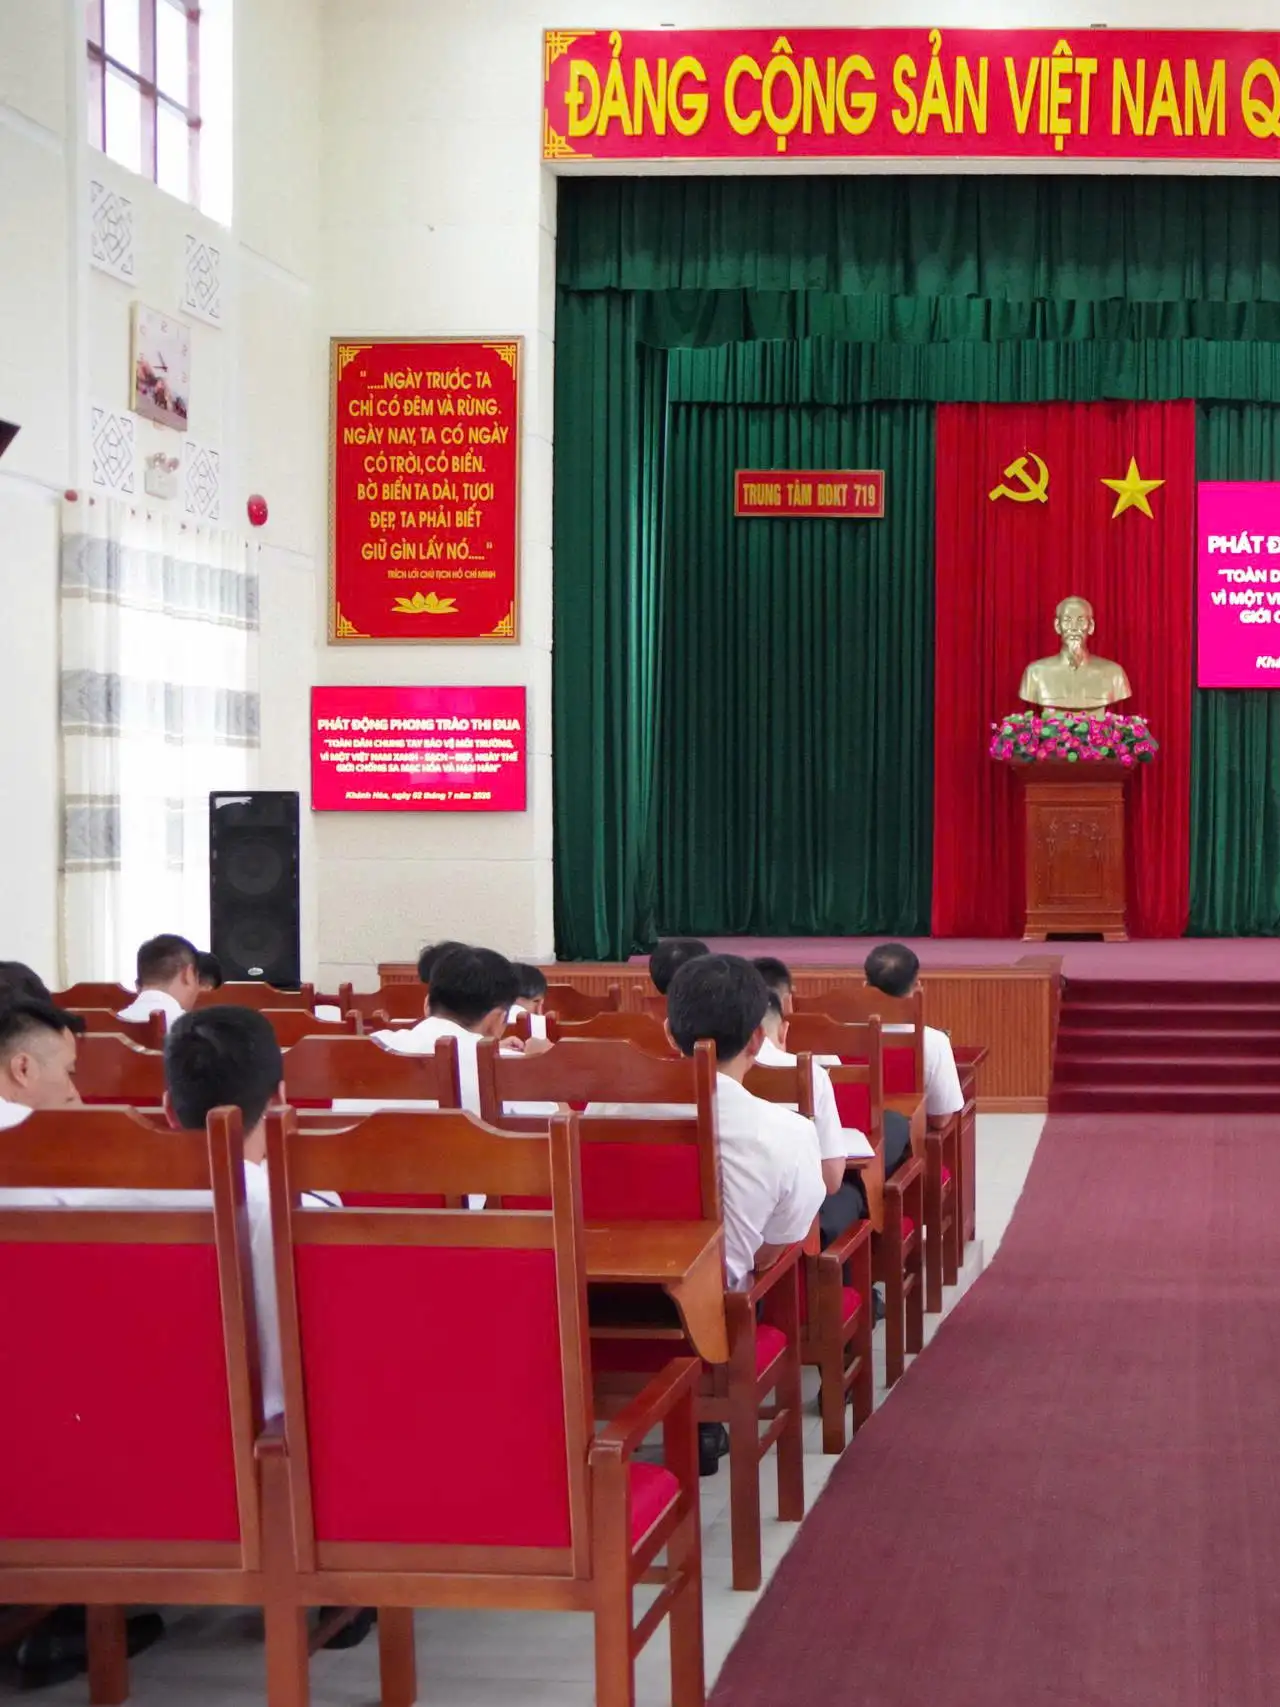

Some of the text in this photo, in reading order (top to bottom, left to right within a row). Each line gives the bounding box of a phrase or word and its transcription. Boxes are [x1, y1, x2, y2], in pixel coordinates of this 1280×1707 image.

[564, 29, 708, 137] ĐẢNG
[724, 36, 878, 152] CỘNG
[892, 29, 988, 135] SẢN
[1004, 40, 1098, 151] VIỆT
[1112, 58, 1225, 136] NAM
[743, 484, 780, 506] TRUNG
[787, 479, 812, 506] TÂM
[854, 484, 876, 507] 719
[1208, 531, 1264, 554] PHÁT
[1211, 588, 1227, 606] VÌ
[1229, 588, 1264, 608] MỘT
[1240, 608, 1272, 624] GIỚI
